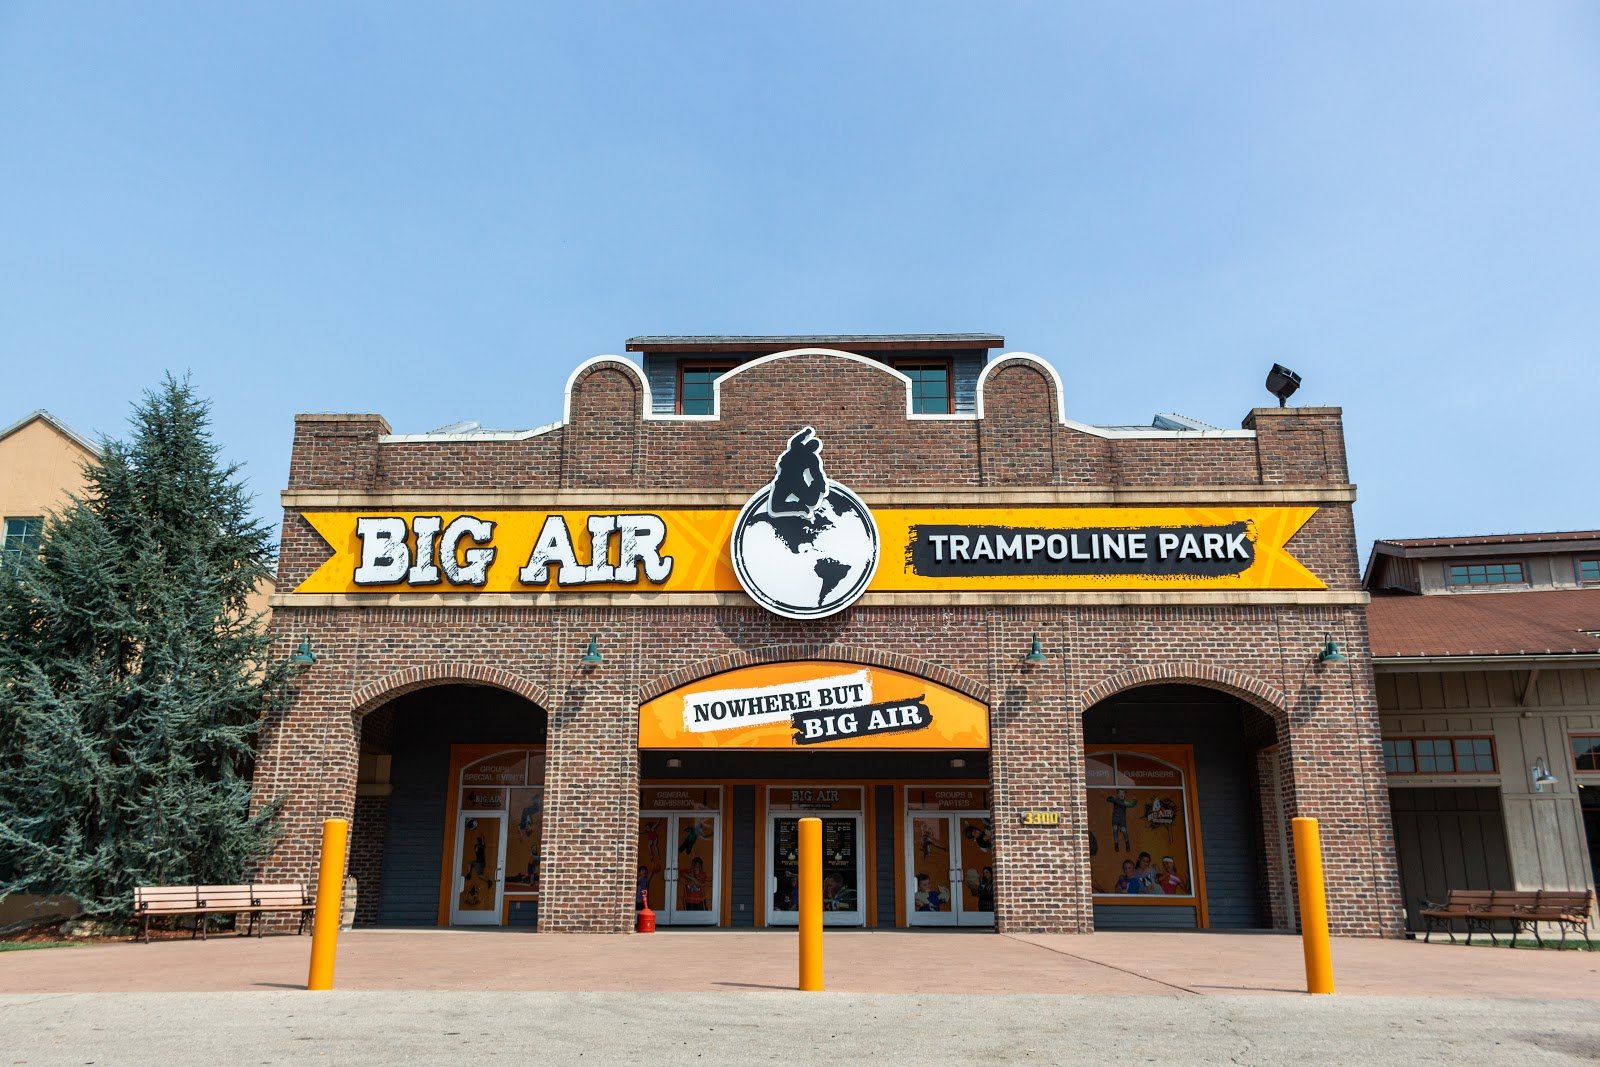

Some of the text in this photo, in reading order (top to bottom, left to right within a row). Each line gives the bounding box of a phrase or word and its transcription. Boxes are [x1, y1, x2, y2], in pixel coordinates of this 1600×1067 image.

[354, 514, 674, 586] BIG AIR
[928, 533, 1250, 561] TRAMPOLINE PARK
[693, 683, 864, 722] NOWHERE BUT
[803, 704, 923, 739] BIG AIR
[656, 791, 690, 799] GENERAL
[791, 790, 840, 802] BIG AIR
[935, 791, 966, 799] GROUPS
[653, 799, 695, 807] ADMISSION
[938, 799, 970, 807] PARTIES
[1023, 812, 1058, 824] 3300
